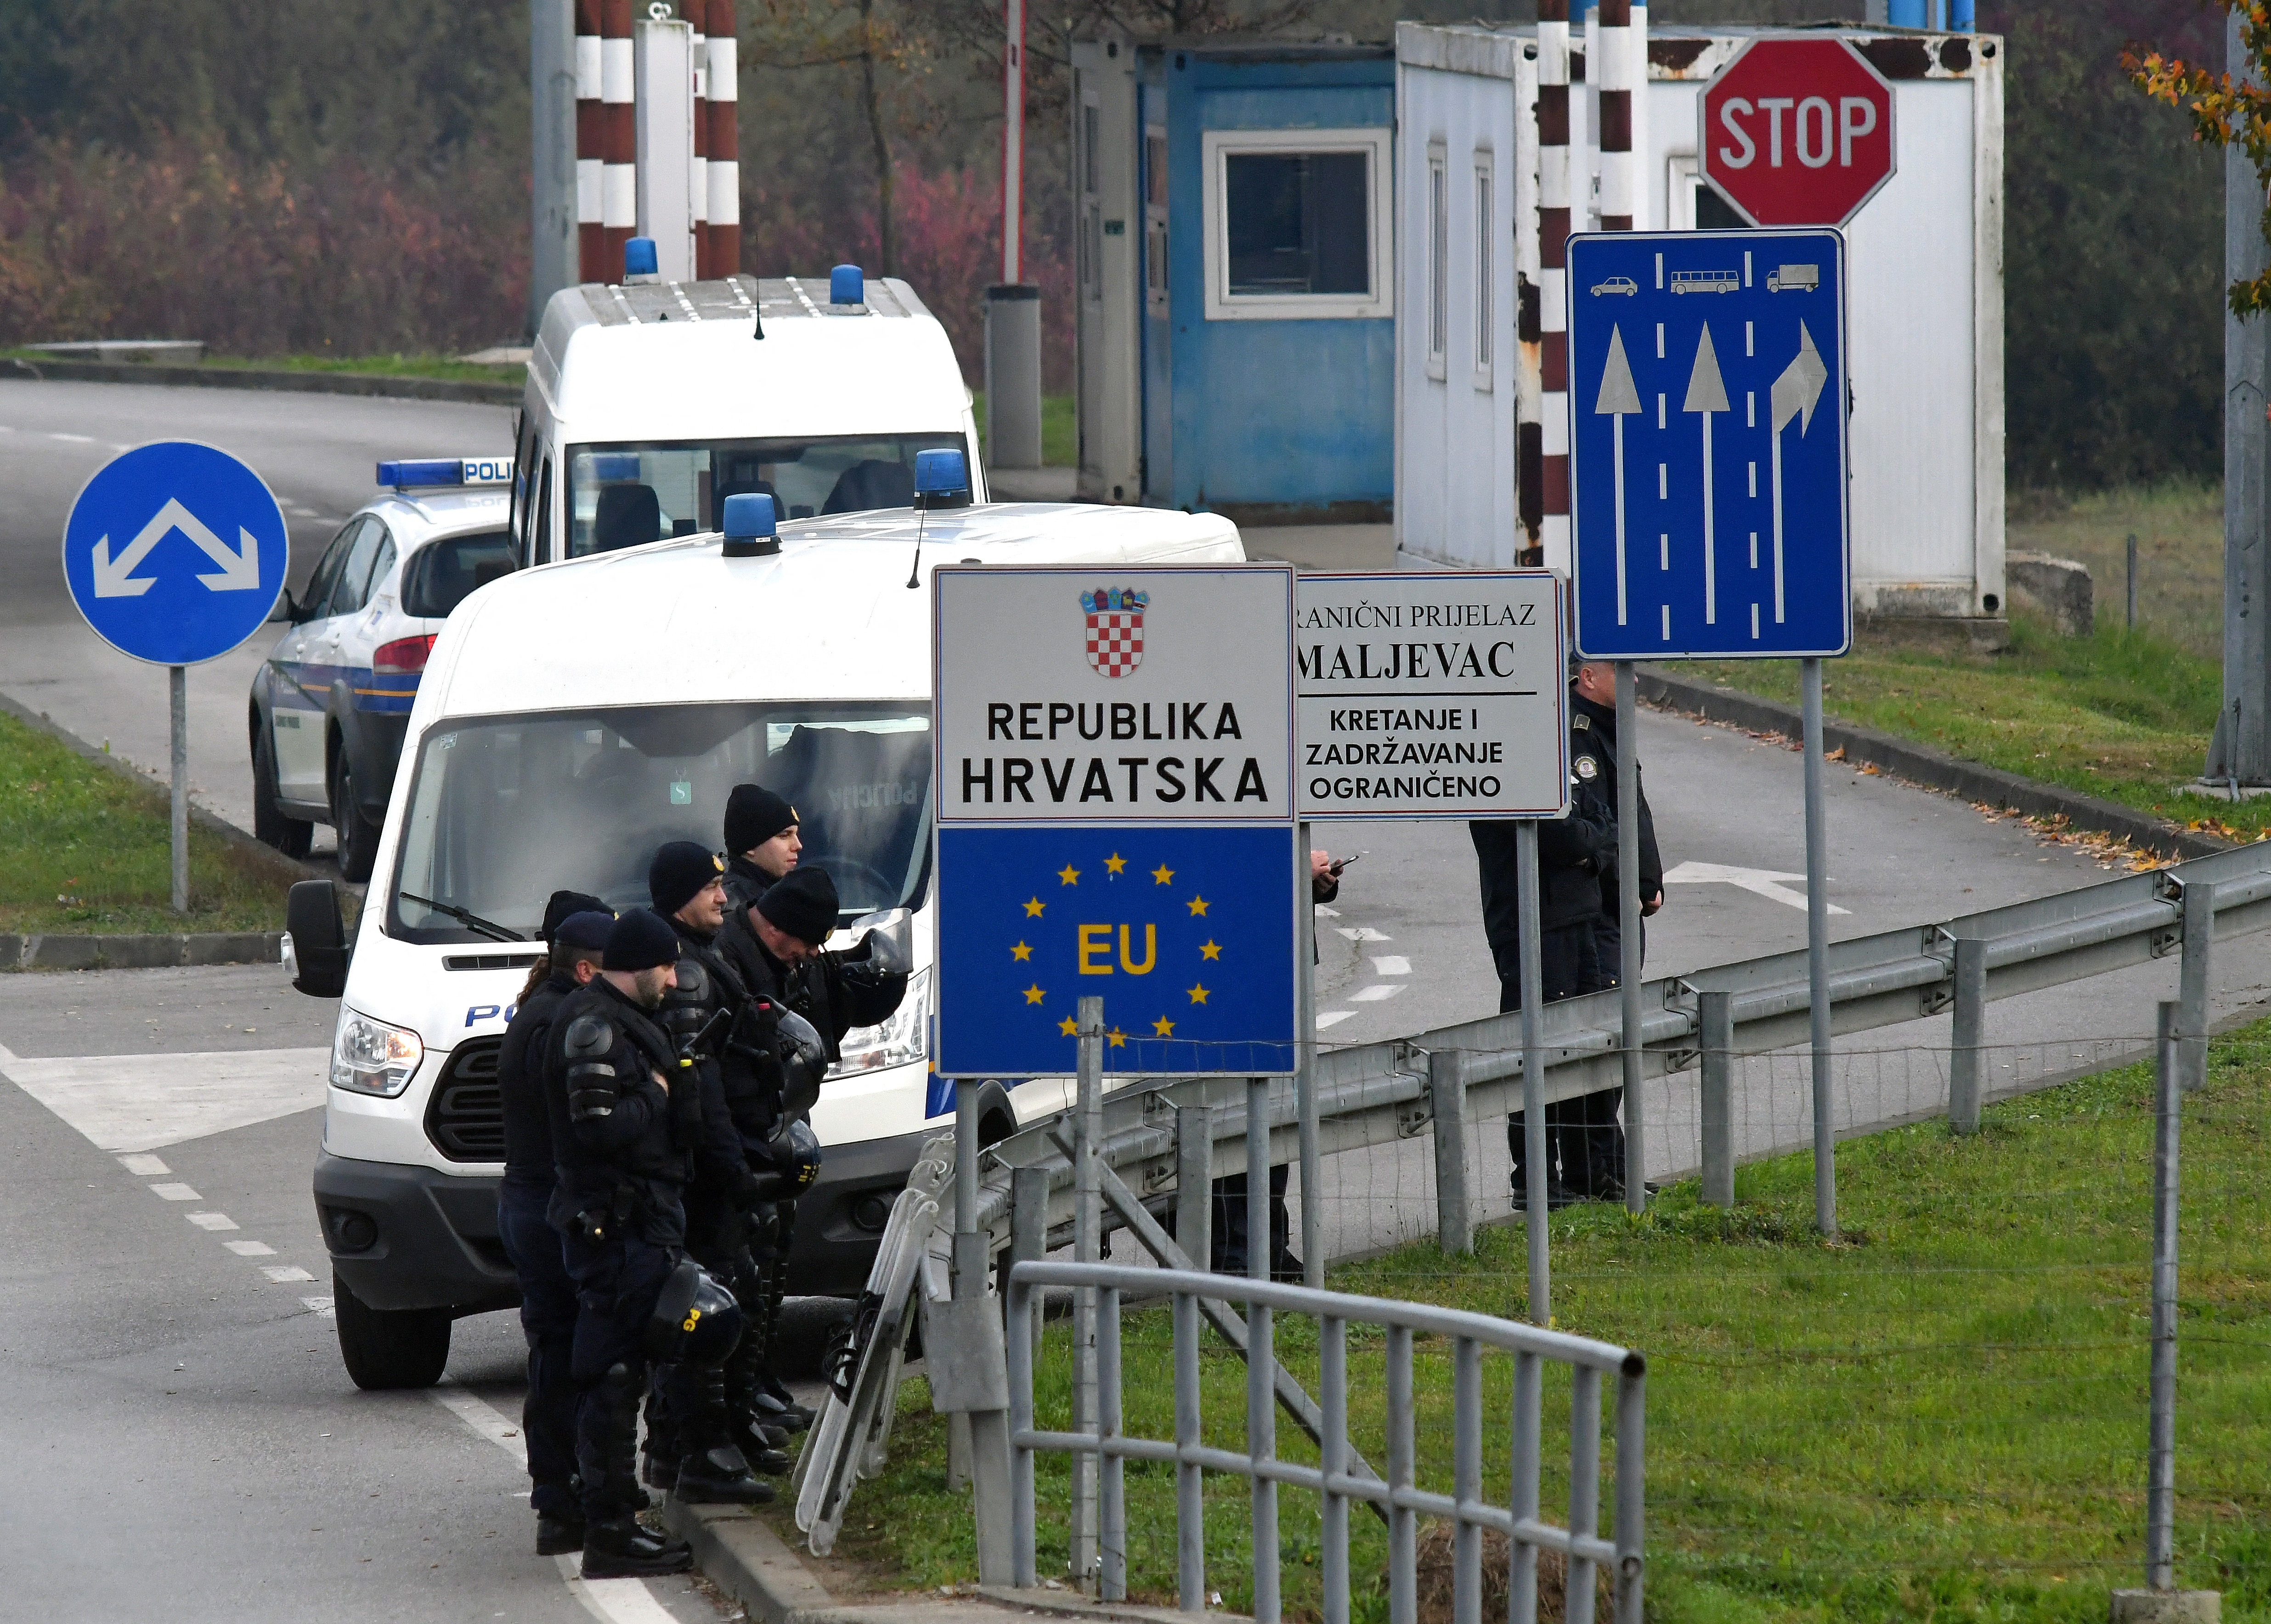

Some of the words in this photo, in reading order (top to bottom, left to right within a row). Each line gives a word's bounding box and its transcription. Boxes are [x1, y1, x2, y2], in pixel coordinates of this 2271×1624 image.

[1719, 96, 1877, 169] STOP
[465, 462, 511, 481] POLI
[1298, 599, 1403, 628] ANIČNI
[1409, 603, 1537, 627] PRIJELAZ
[1298, 641, 1514, 680] MALJEVAC
[988, 702, 1243, 741] REPUBLIKA
[1330, 708, 1462, 732] KRETANJE
[1471, 708, 1478, 730] I
[1305, 735, 1503, 766] ZADRŽAVANJE
[962, 756, 1269, 804] HRVATSKA
[1309, 769, 1501, 800] OGRANIČENO
[1078, 923, 1157, 976] EU
